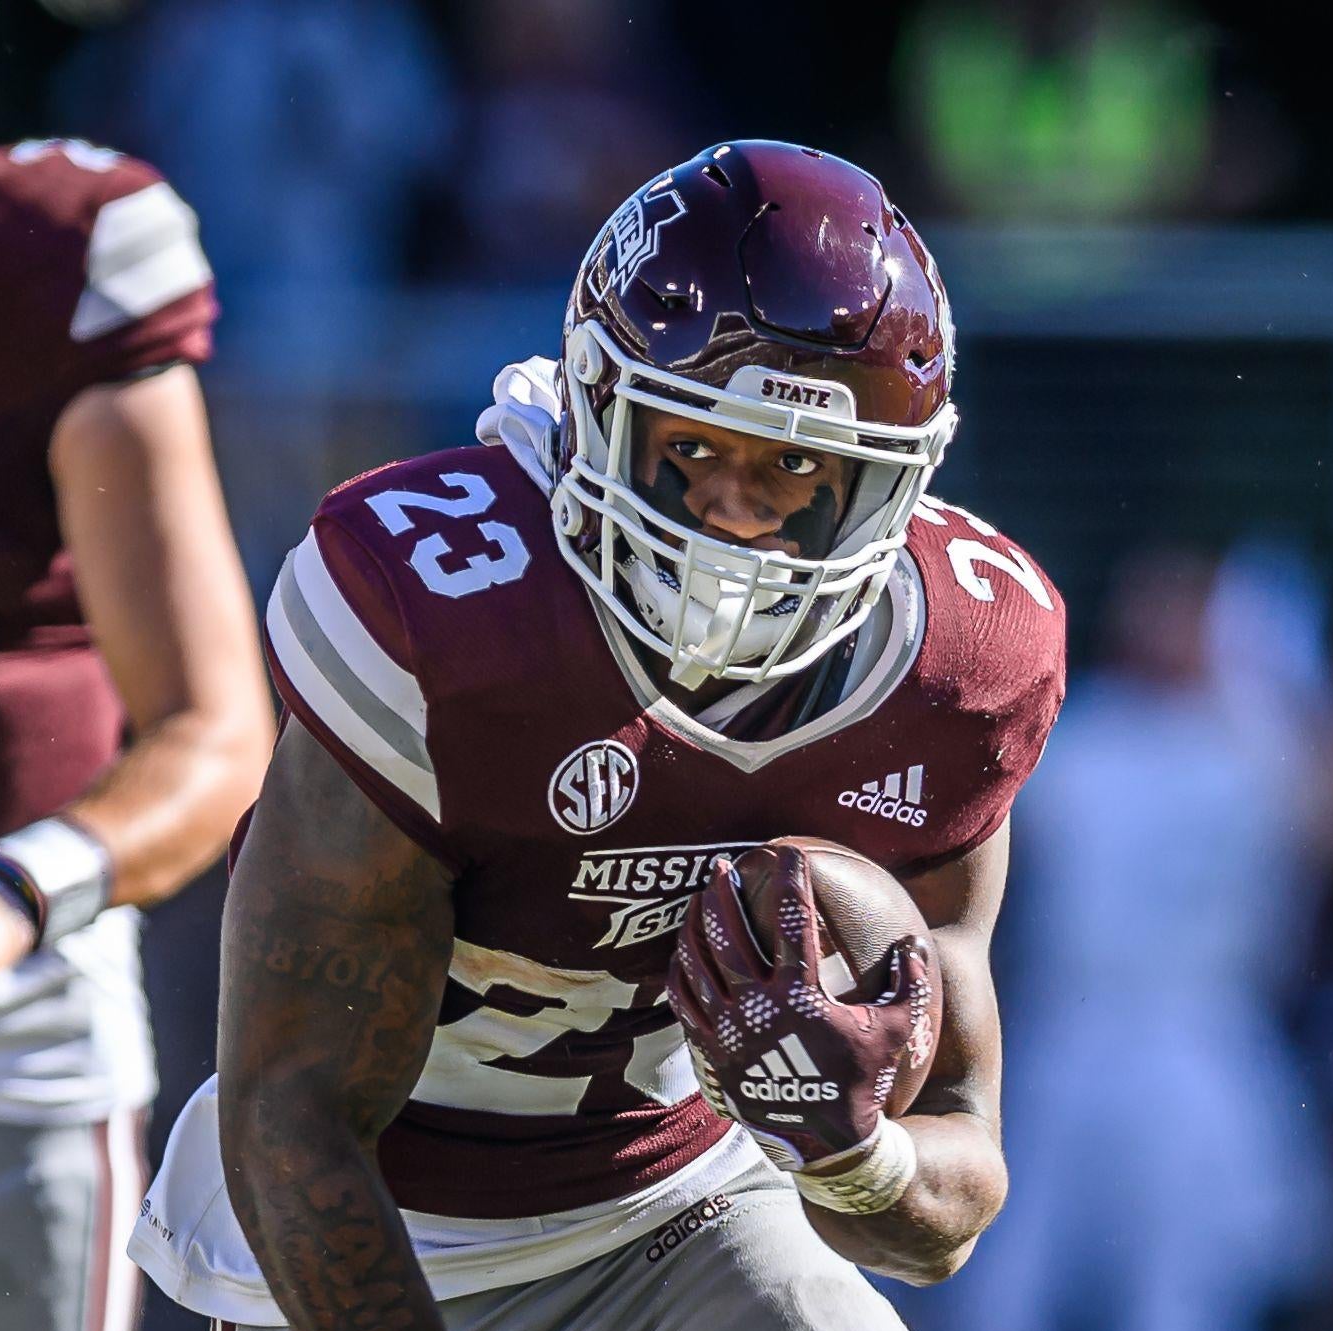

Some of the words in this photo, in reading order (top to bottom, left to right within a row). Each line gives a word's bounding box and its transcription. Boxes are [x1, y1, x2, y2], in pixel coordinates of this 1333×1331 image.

[760, 377, 832, 409] STATE
[363, 472, 533, 600] 23
[557, 748, 632, 830] SEC
[837, 788, 929, 828] adidas
[739, 1075, 841, 1103] adidas
[645, 1193, 733, 1264] adidas
